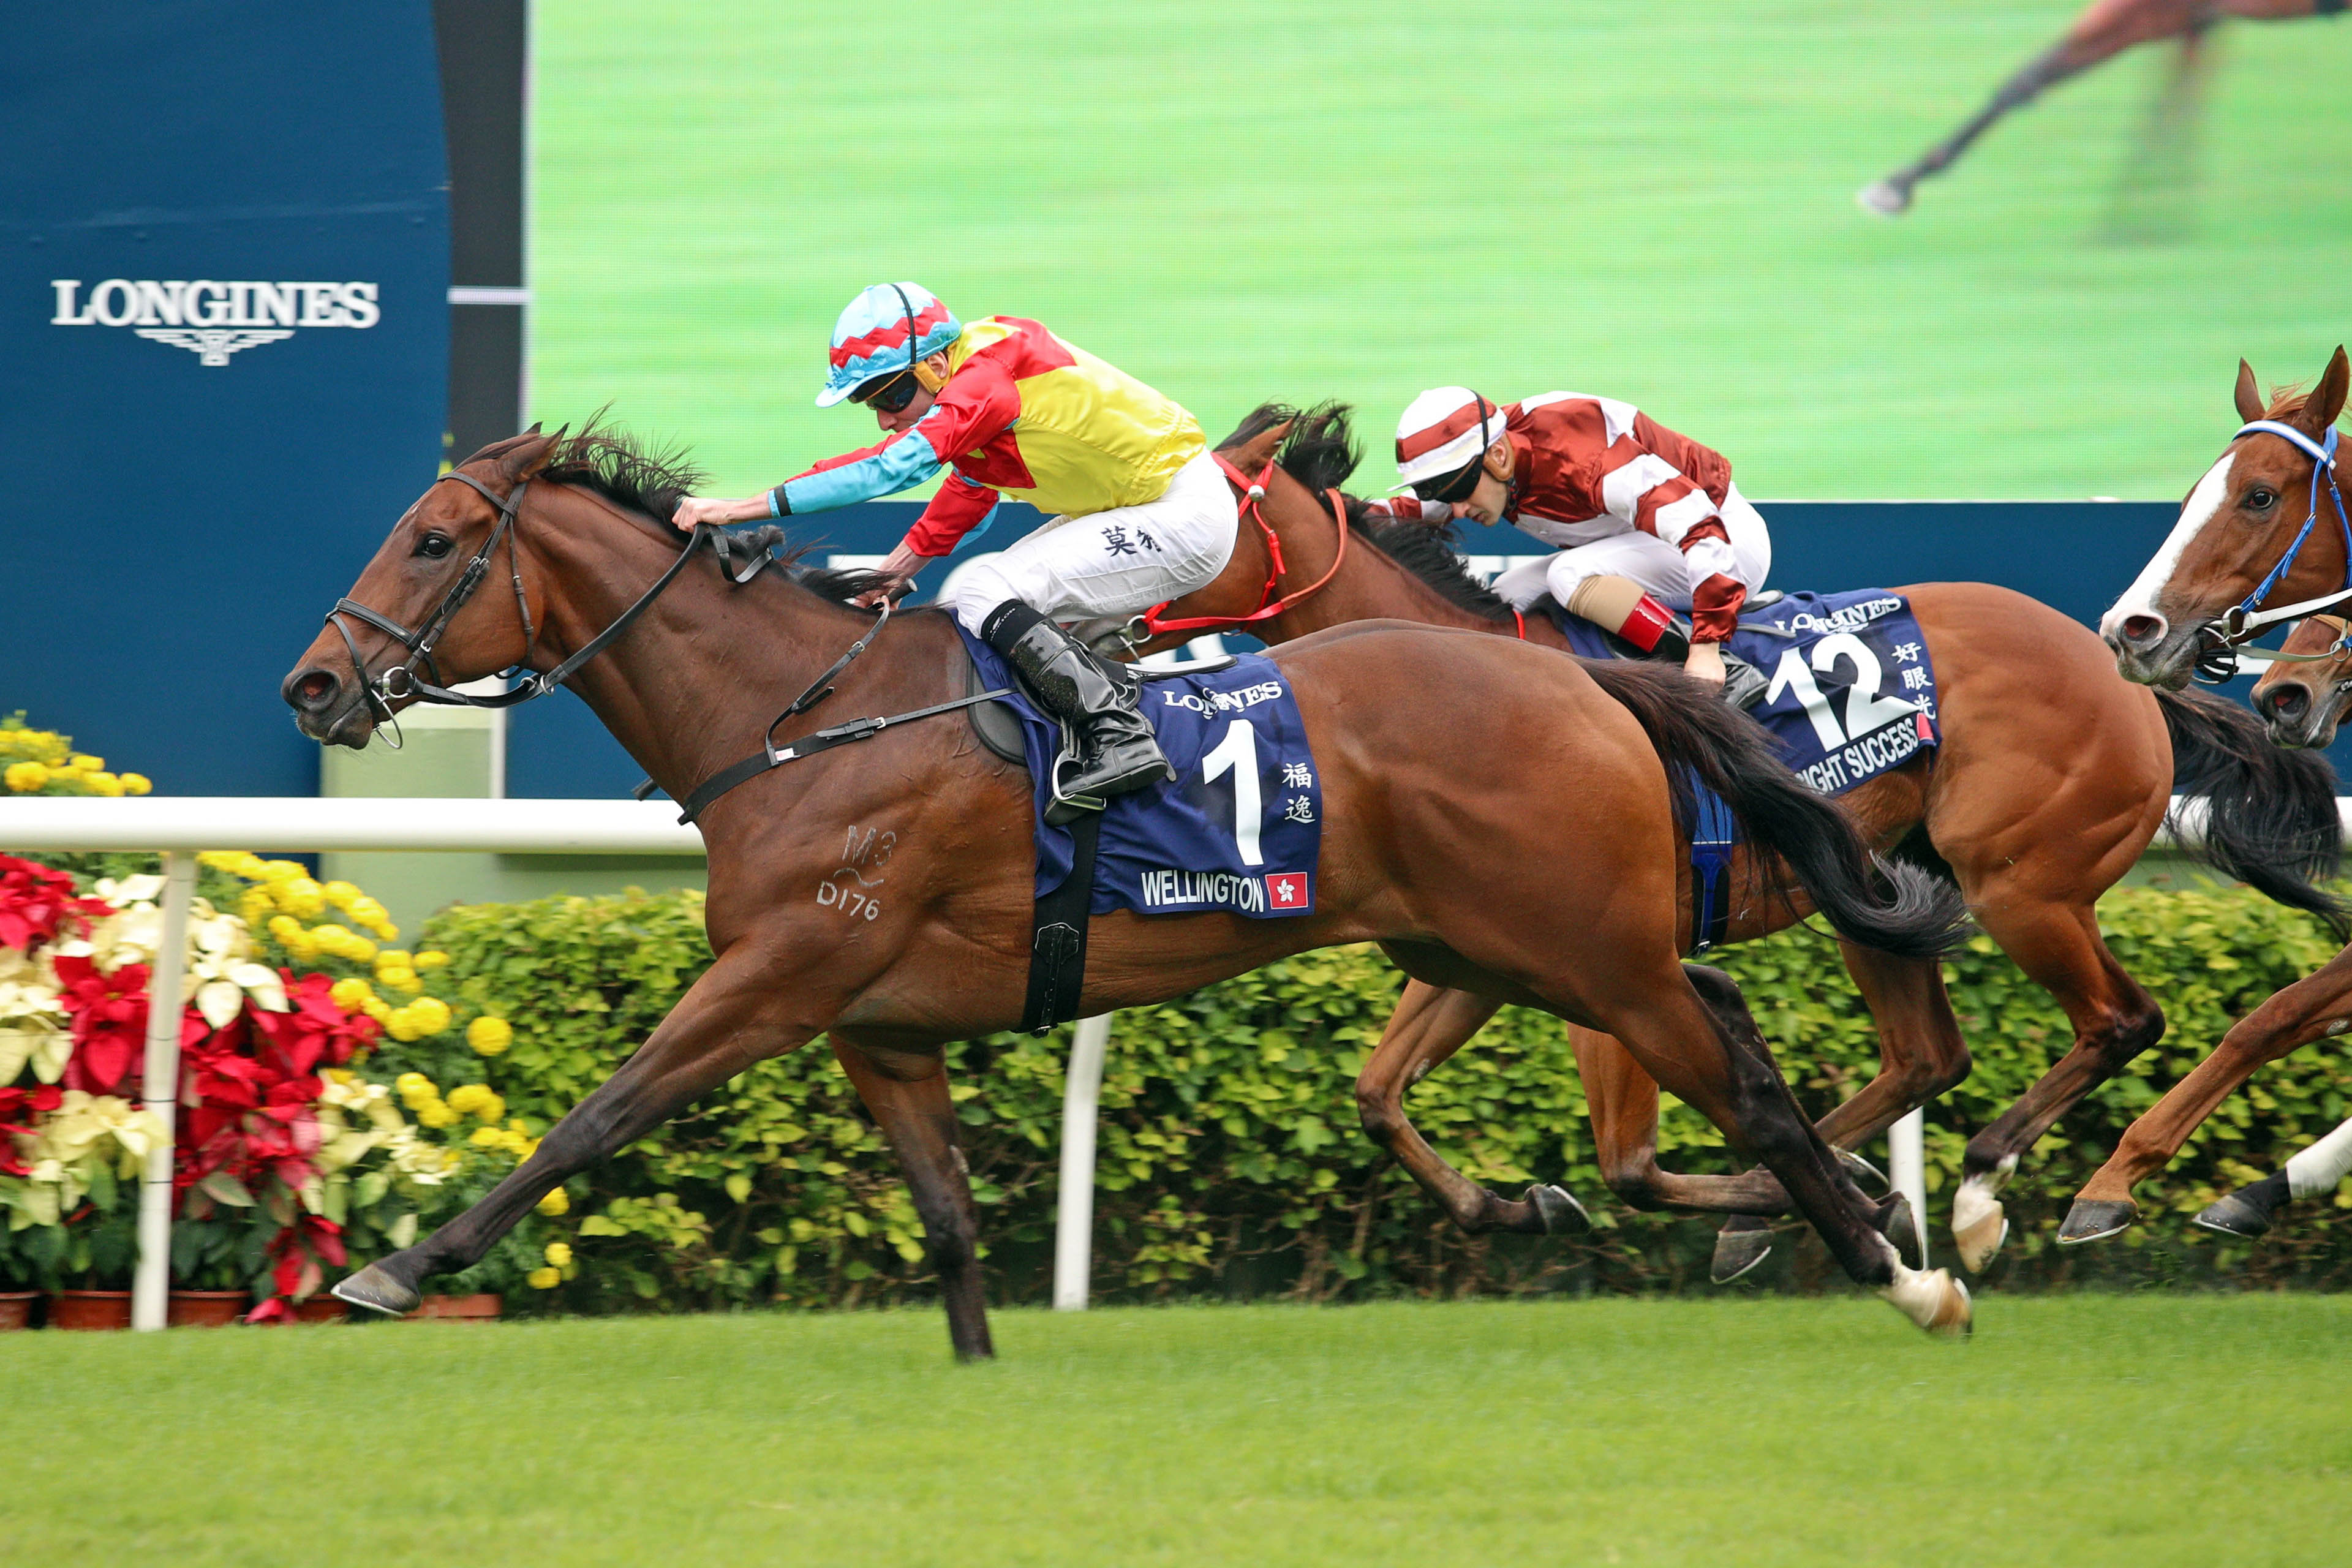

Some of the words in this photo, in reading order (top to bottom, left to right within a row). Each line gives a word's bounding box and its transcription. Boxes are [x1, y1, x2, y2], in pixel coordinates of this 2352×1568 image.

[50, 279, 380, 329] LONGINES
[1162, 680, 1283, 716] LONNES
[1764, 633, 1922, 753] 12
[1891, 641, 1937, 720] 好眼光
[1845, 717, 1918, 779] SUCCESS
[1202, 718, 1265, 866] 1
[1282, 762, 1316, 824] 福逸
[816, 880, 881, 921] D176
[1141, 869, 1264, 912] WELLINGTON
